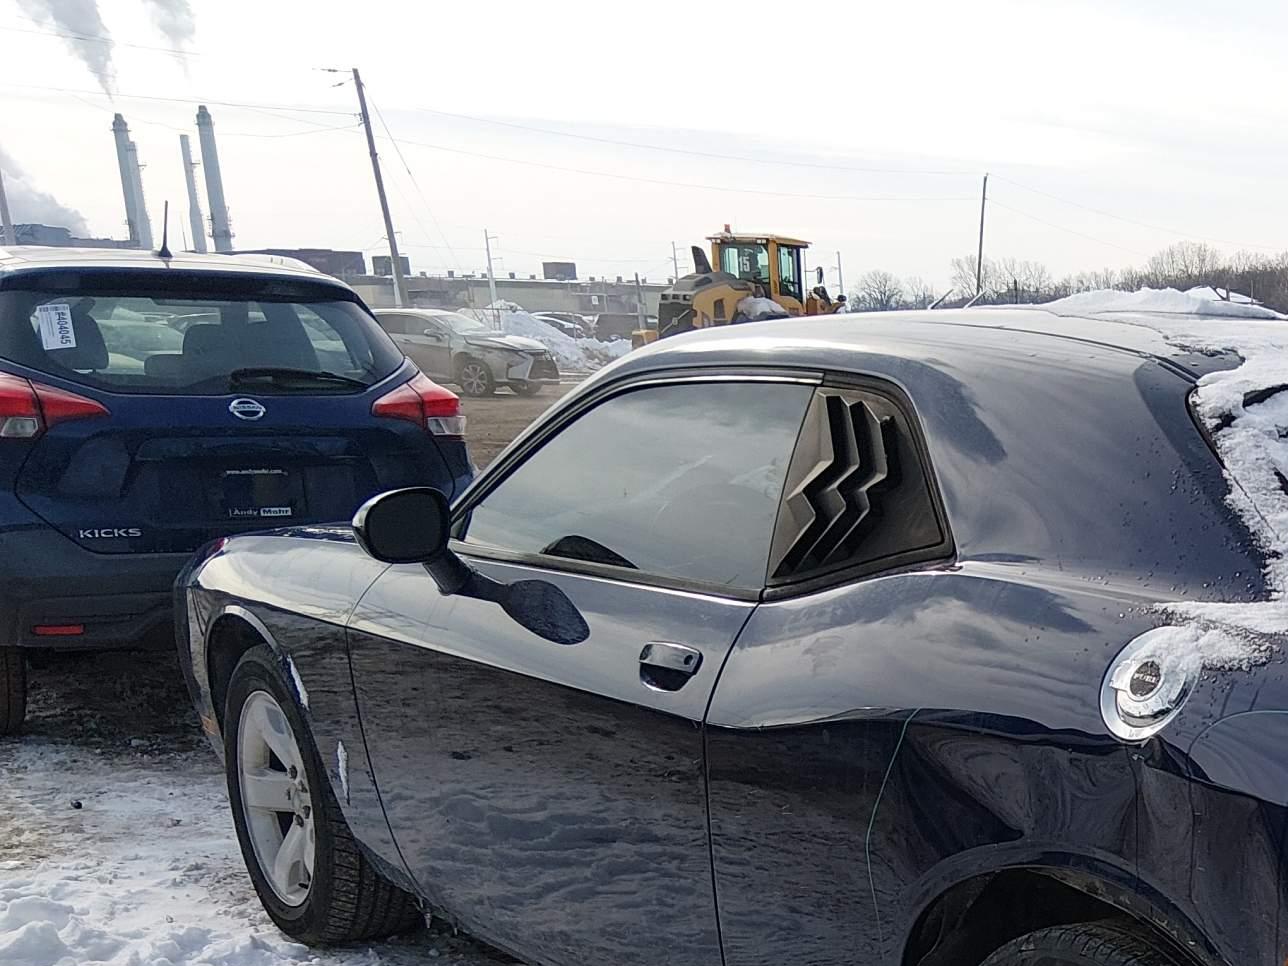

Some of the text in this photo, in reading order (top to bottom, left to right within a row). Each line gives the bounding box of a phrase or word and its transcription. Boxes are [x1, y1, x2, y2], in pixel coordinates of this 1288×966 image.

[738, 255, 751, 272] 15
[233, 507, 258, 516] Andy
[79, 527, 142, 539] KICKS
[1133, 672, 1157, 684] FUEL
